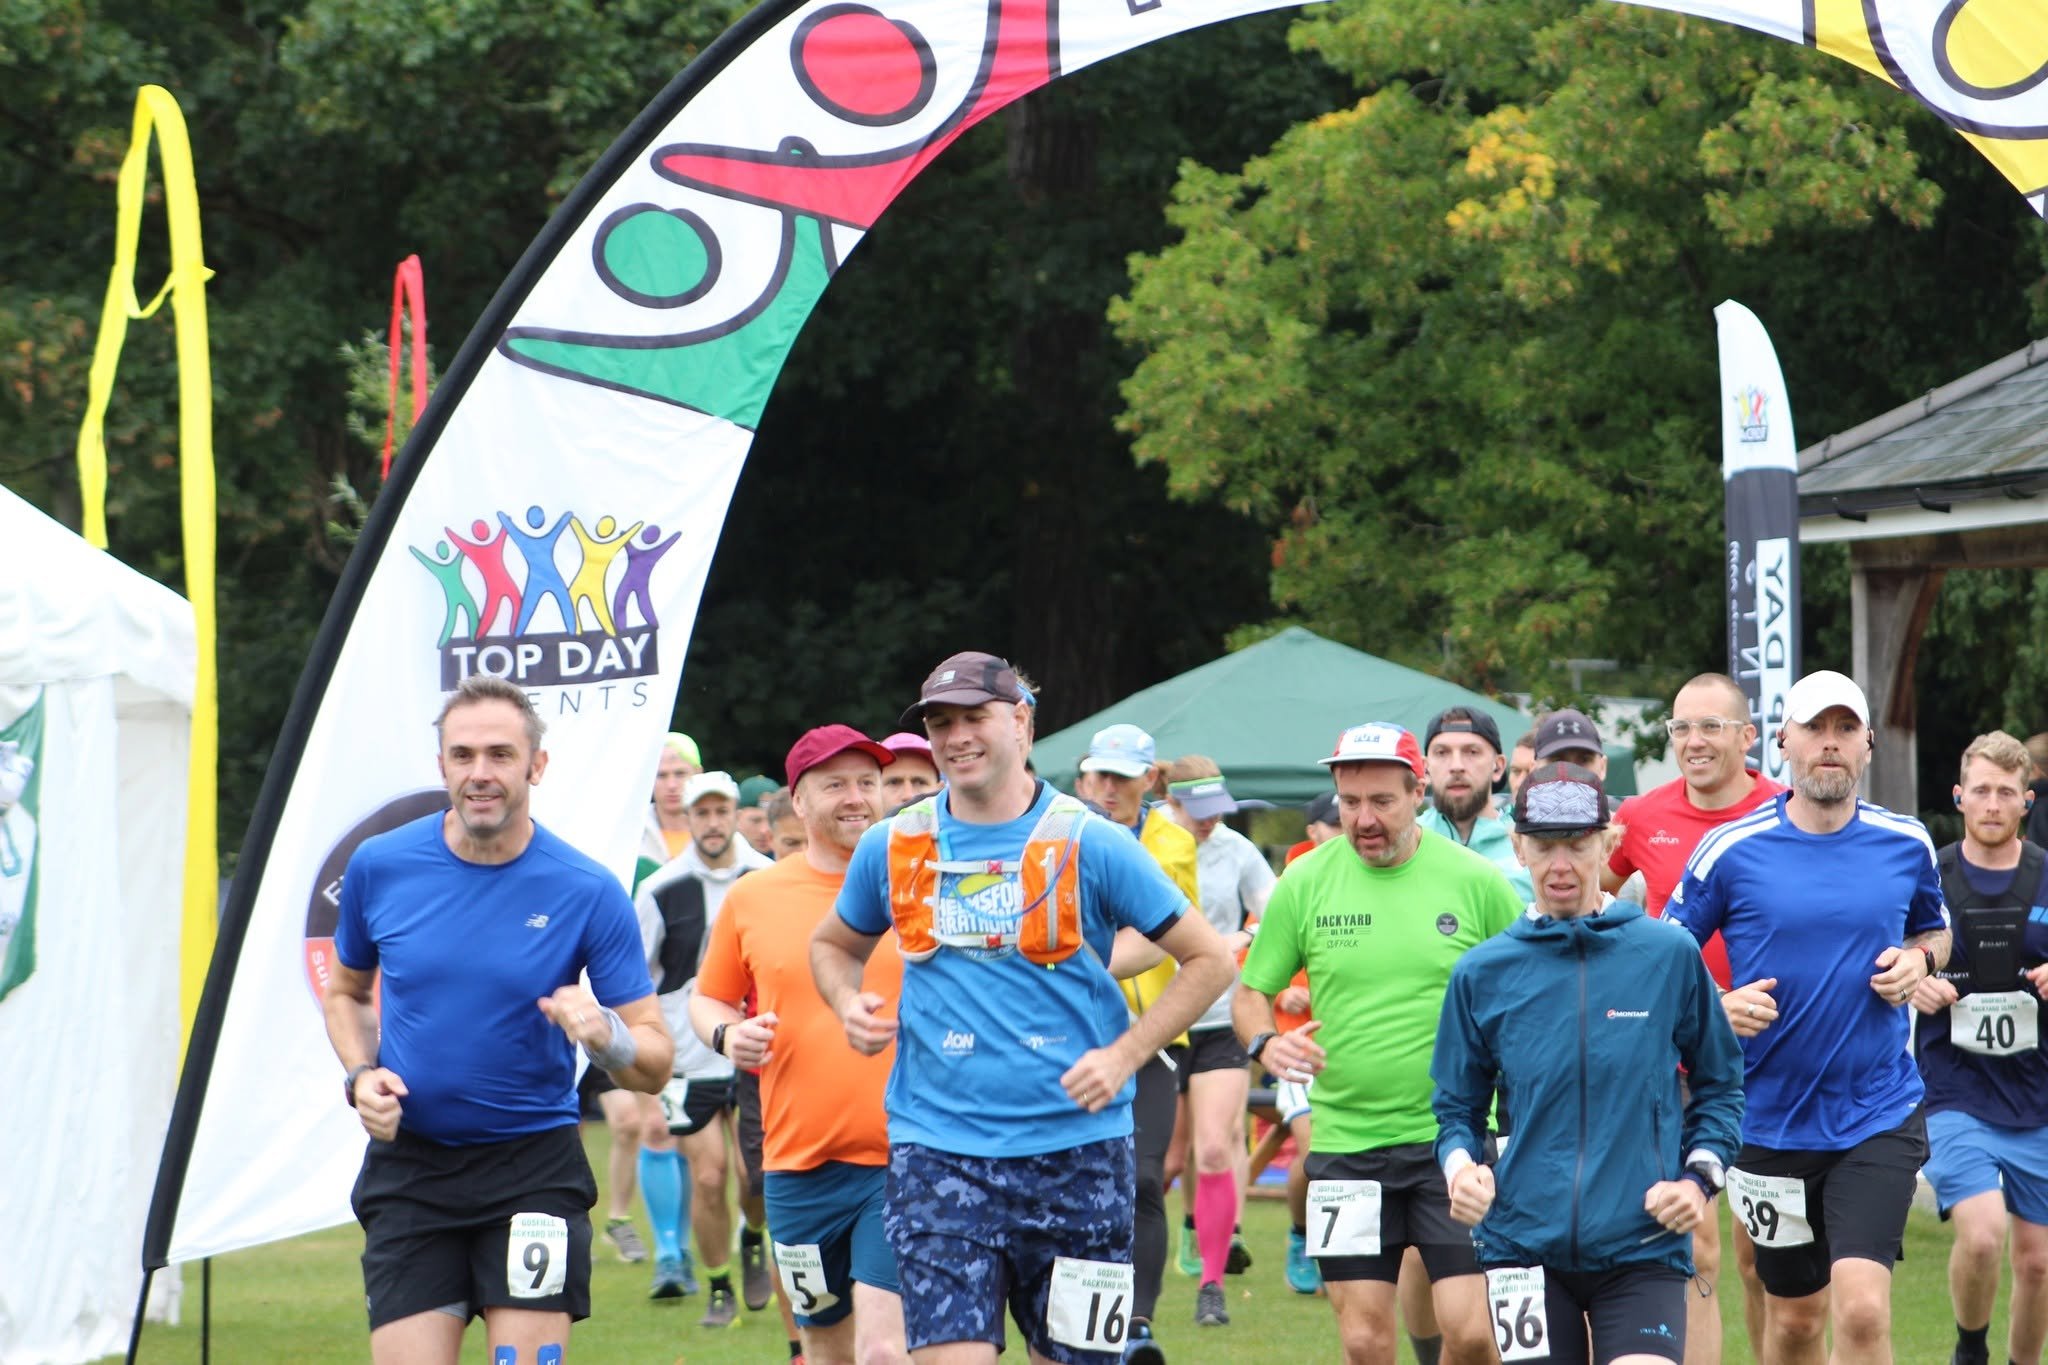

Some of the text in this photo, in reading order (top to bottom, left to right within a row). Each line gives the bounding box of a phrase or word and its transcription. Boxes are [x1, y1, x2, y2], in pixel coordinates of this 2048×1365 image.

[451, 633, 651, 682] TOP DAY
[1315, 913, 1373, 929] BACKYARD
[1330, 928, 1355, 936] ULTRA
[1326, 938, 1360, 949] SUFFOLK
[1615, 1010, 1650, 1018] MONTANE
[1975, 1013, 2016, 1050] 40
[942, 1029, 975, 1049] AON
[1320, 1205, 1341, 1249] 7
[1742, 1195, 1779, 1241] 39
[523, 1241, 550, 1290] 9
[791, 1270, 818, 1310] 5
[1084, 1291, 1125, 1345] 16
[1494, 1296, 1544, 1353] 56
